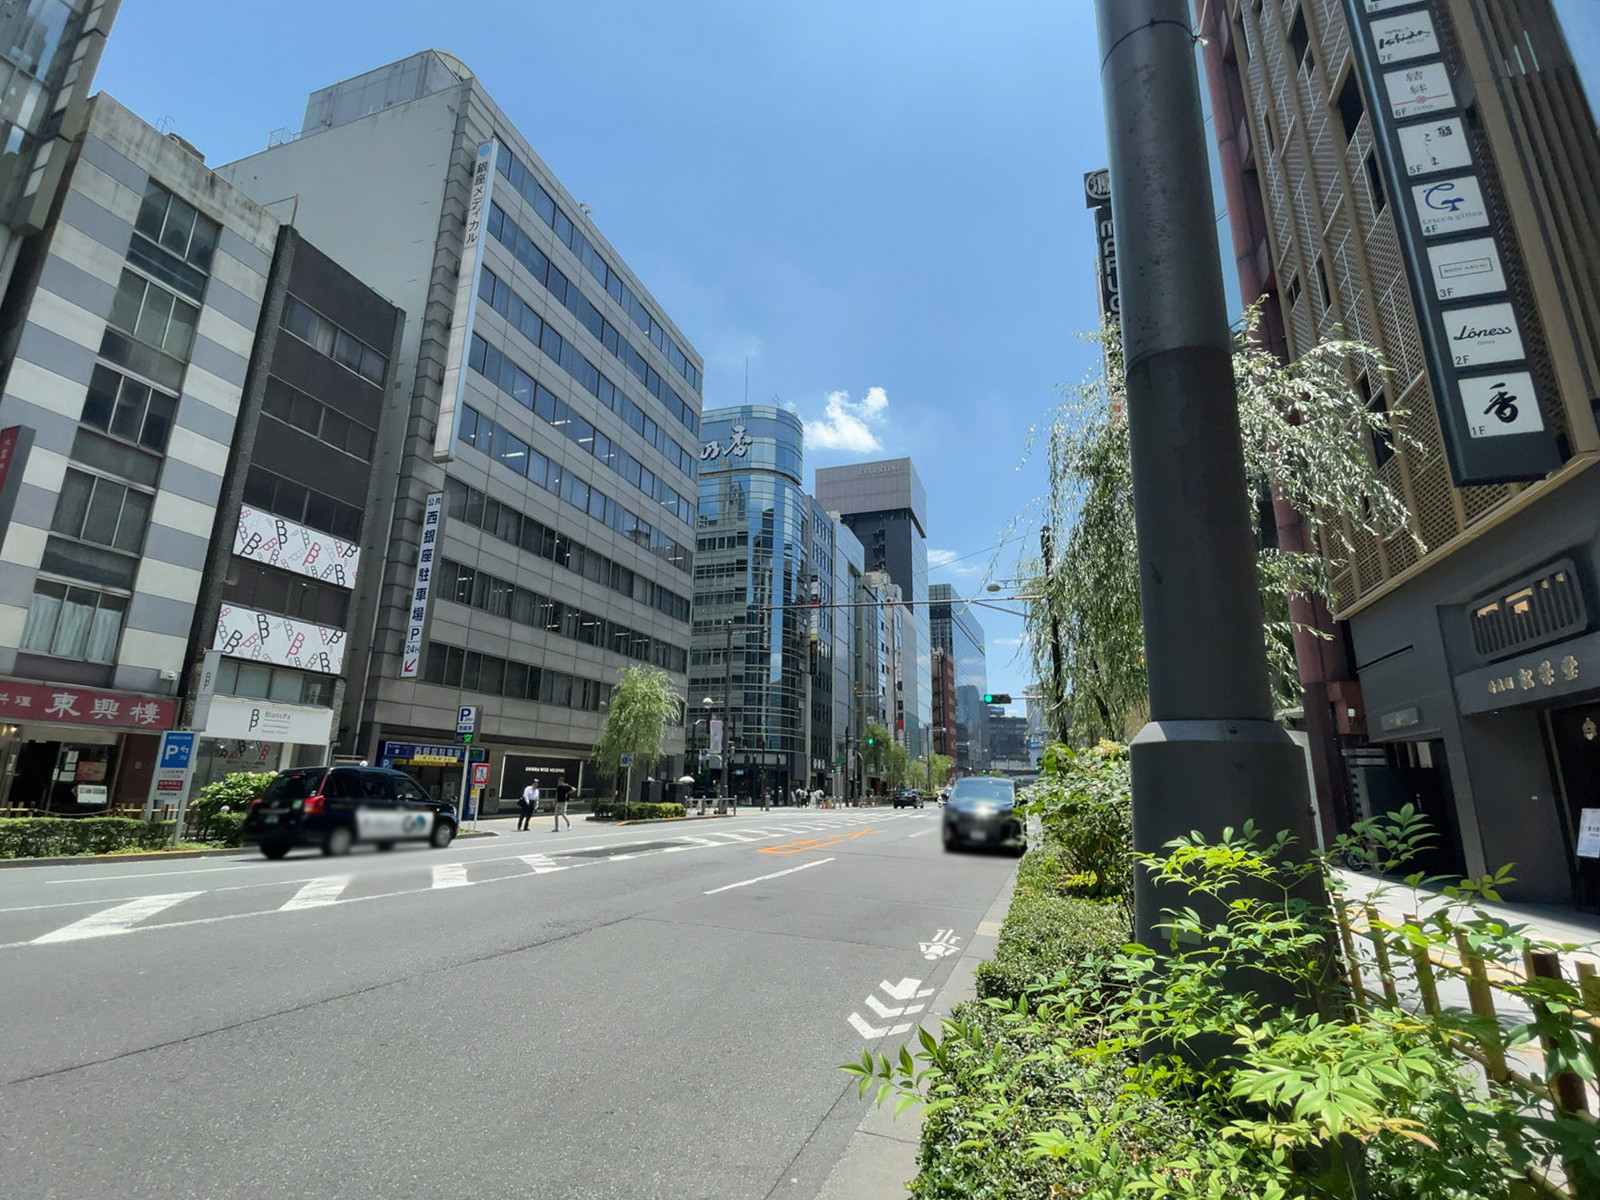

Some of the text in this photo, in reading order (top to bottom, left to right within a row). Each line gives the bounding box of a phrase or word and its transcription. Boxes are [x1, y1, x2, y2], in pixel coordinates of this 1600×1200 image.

[1381, 54, 1393, 62] 7F
[1395, 107, 1408, 117] 6F
[1409, 164, 1423, 174] 5F
[466, 161, 488, 244] 銀座メディカル
[1425, 224, 1439, 234] 4F
[1440, 287, 1454, 298] 3F
[1455, 354, 1470, 365] 2F
[1483, 382, 1519, 424] 香
[1471, 425, 1486, 436] 1F
[428, 498, 442, 507] 公共
[411, 510, 439, 622] 西銀座駐車場
[411, 629, 420, 640] P
[45, 692, 161, 725] 東興樓
[460, 708, 472, 721] P
[165, 745, 179, 760] P
